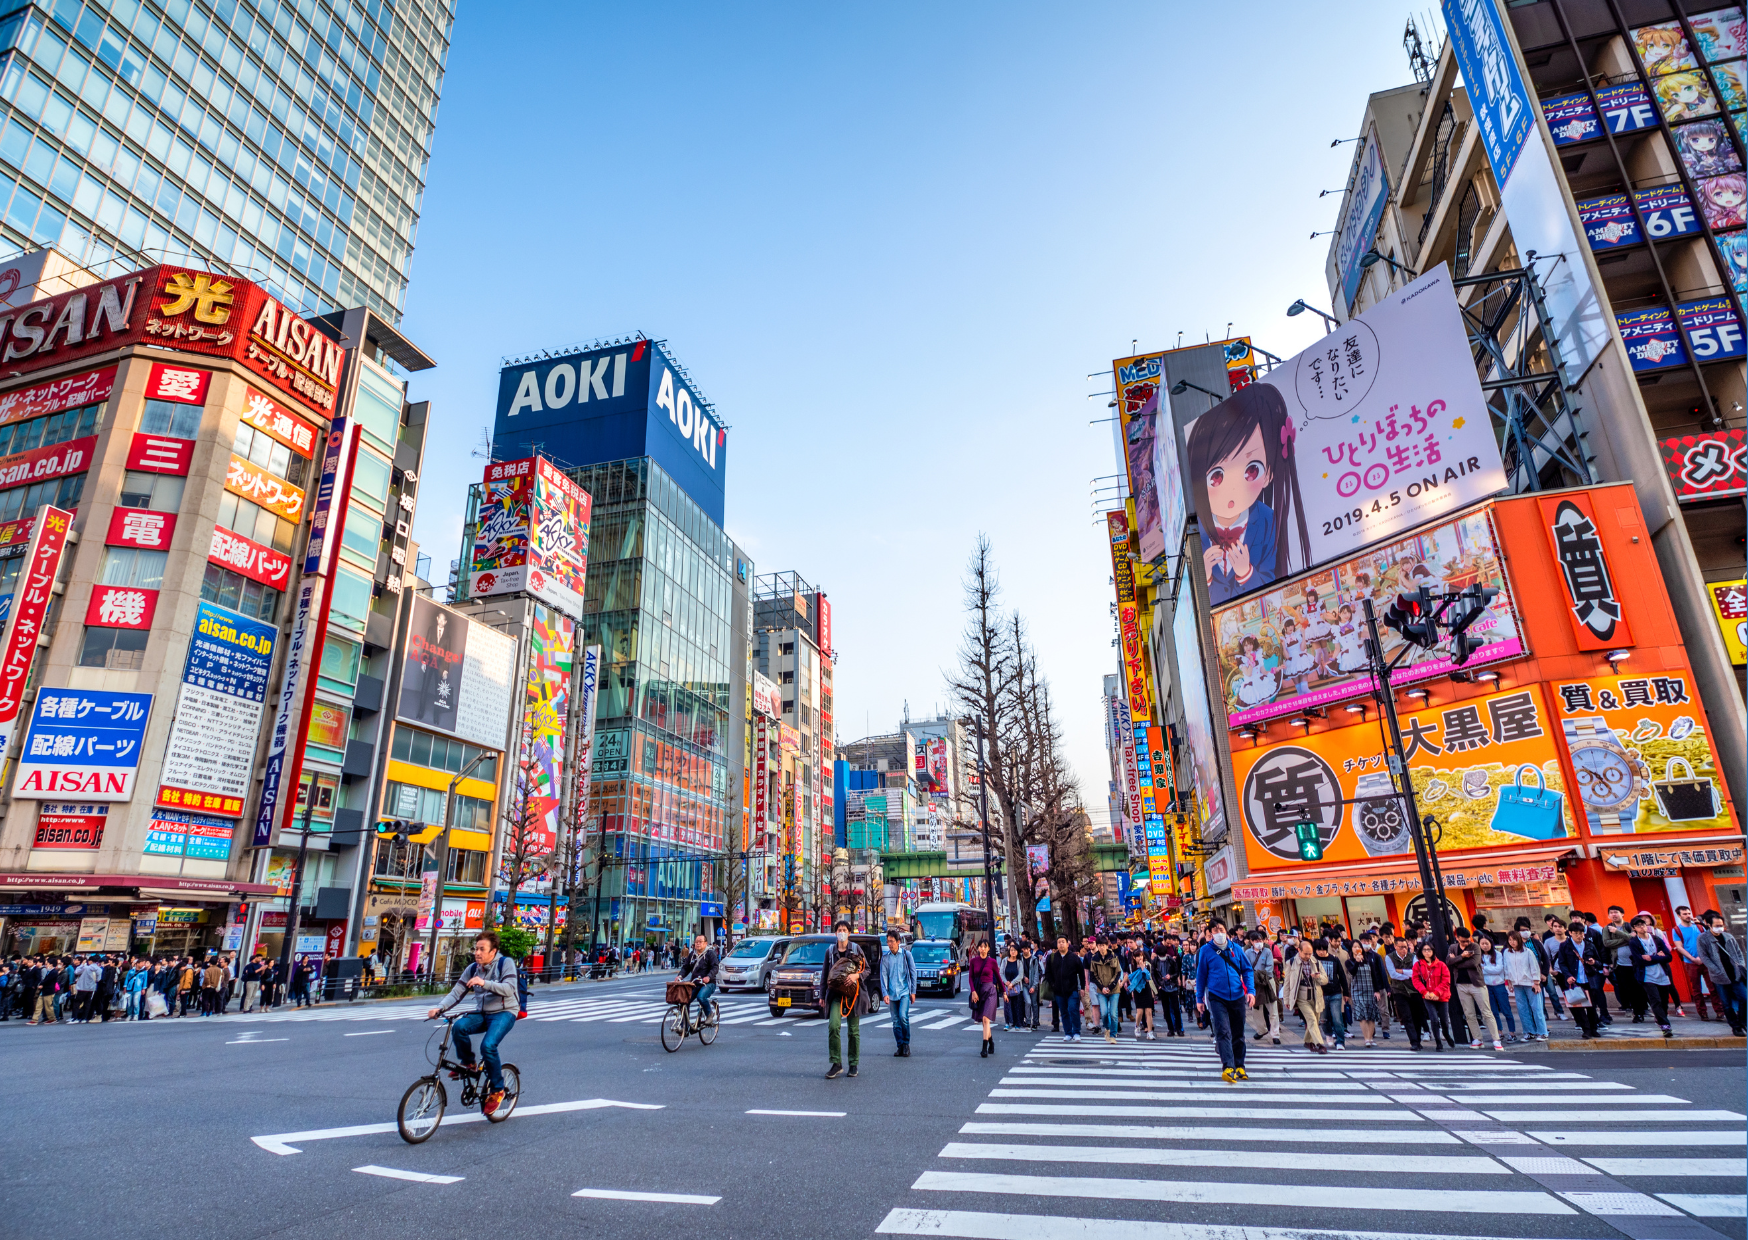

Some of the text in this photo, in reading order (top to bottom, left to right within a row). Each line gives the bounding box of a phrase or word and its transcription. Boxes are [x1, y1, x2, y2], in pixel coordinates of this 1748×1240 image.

[1542, 86, 1640, 111] トレーディング カードゲーム
[1545, 105, 1592, 120] アメニティ
[1552, 119, 1598, 134] AMENITY
[1559, 125, 1596, 139] DREAM
[1606, 104, 1654, 133] 7F
[1578, 186, 1680, 211] トレーディング カードゲーム
[1580, 206, 1631, 222] アメニティ
[1588, 221, 1636, 237] AMENITY
[1645, 206, 1696, 237] 6F
[1594, 228, 1634, 242] DREAM
[161, 272, 235, 325] 光
[1406, 277, 1440, 303] KADOKAWA
[1618, 299, 1727, 326] トレーディング カードゲーム
[145, 317, 234, 347] ネットワーク
[252, 296, 344, 388] AISAN
[1620, 322, 1673, 338] アメニティ
[1691, 323, 1744, 357] 5F
[1342, 334, 1365, 378] 友達に
[1628, 338, 1679, 354] AMENITY
[1637, 346, 1679, 362] DREAM
[157, 369, 201, 400] 愛
[247, 343, 334, 410] ケーブル・配線部材
[508, 353, 627, 417] AOKI
[1327, 349, 1350, 401] なりたい
[242, 393, 314, 452] 光通信
[656, 366, 717, 470] AOKI
[1322, 398, 1447, 467] ひとりぼっちの
[139, 438, 184, 470] 三
[490, 461, 530, 480] 免税店
[543, 460, 588, 507] 愛客免税店
[226, 461, 305, 515] ネットワーク
[1321, 455, 1481, 537] 2019.4.5 ON AIR
[122, 512, 166, 546] 電
[481, 511, 519, 543] AKKY
[540, 517, 574, 552] AKKY
[208, 531, 289, 581] 配線パーツ
[386, 492, 414, 594] 坂口電熱
[1113, 543, 1128, 551] DVD
[1113, 550, 1129, 558] ブルーレイ
[1117, 562, 1128, 570] CD
[1551, 517, 1621, 626] 質
[99, 589, 146, 625] 機
[199, 618, 272, 655] aisan.co.jp
[1472, 618, 1498, 634] cafe
[409, 648, 438, 670] AGA
[412, 634, 464, 664] Change!
[584, 650, 597, 693] AKKY
[40, 695, 144, 722] 各種ケーブル
[753, 699, 771, 714] カラオケ
[1119, 702, 1132, 734] AKKY
[599, 733, 622, 748] 24h
[1401, 690, 1544, 762] 大黒屋
[29, 734, 136, 759] 配線パーツ
[597, 749, 622, 757] OPEN
[20, 770, 128, 794] AISAN
[1151, 749, 1167, 789] 吉野家
[1164, 750, 1174, 788] YOSHINOYA
[162, 789, 181, 803] 各社
[183, 792, 202, 806] 特約
[204, 796, 222, 809] 在庫
[257, 759, 280, 838] AISAN
[757, 768, 765, 806] カラオケ
[1124, 745, 1141, 824] Tax-free Shop
[1144, 813, 1152, 821] 1F
[1253, 757, 1338, 850] 質
[795, 794, 803, 854] ラムタラ
[1147, 830, 1164, 838] DVD
[1156, 838, 1167, 846] 中古
[1632, 848, 1743, 867] 1階にて高価買取中
[1233, 887, 1269, 900] 高価買取
[1497, 865, 1556, 884] 無料査定
[40, 905, 61, 913] 1949
[467, 908, 482, 918] au
[1357, 917, 1382, 926] 大黒屋
